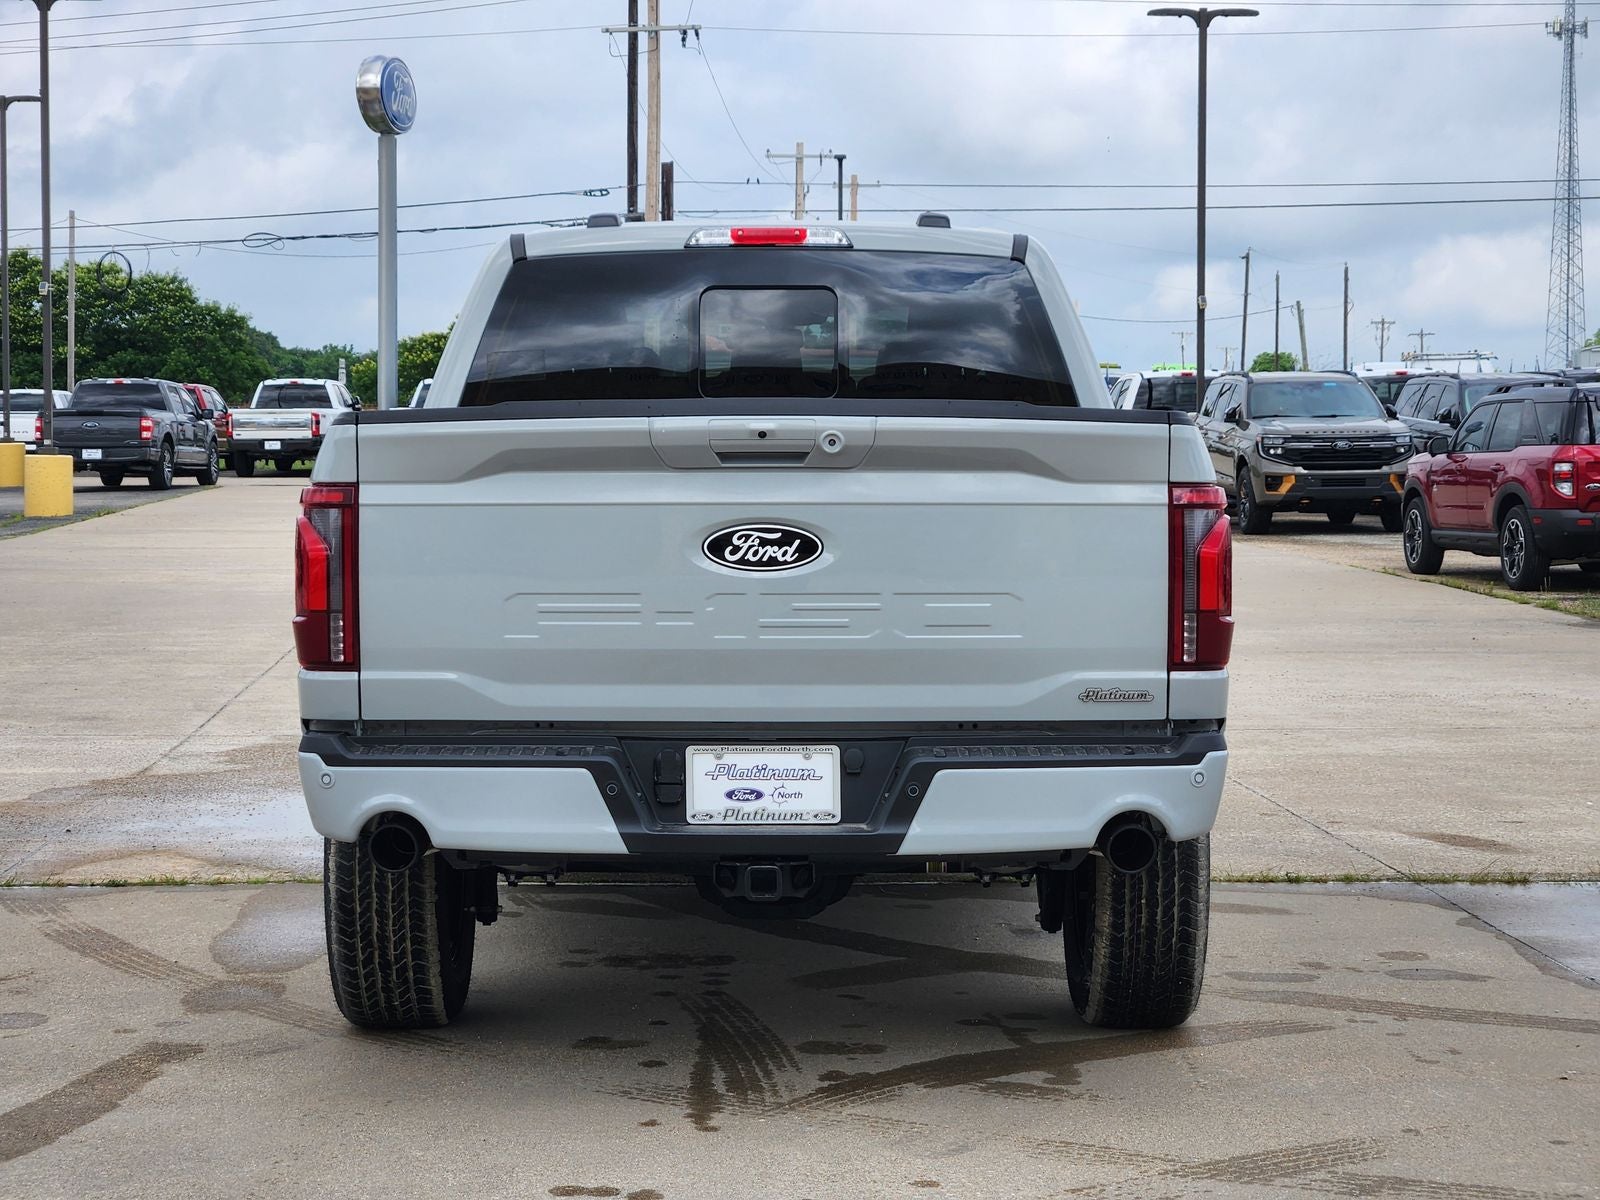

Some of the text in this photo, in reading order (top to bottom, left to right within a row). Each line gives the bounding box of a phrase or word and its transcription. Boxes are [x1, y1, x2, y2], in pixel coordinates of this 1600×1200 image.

[392, 71, 412, 117] Ford
[724, 530, 801, 562] Ford
[1078, 687, 1155, 703] Platinum
[704, 764, 824, 781] Platinum
[731, 788, 757, 801] Ford
[777, 791, 803, 799] North
[722, 808, 811, 822] Platinum
